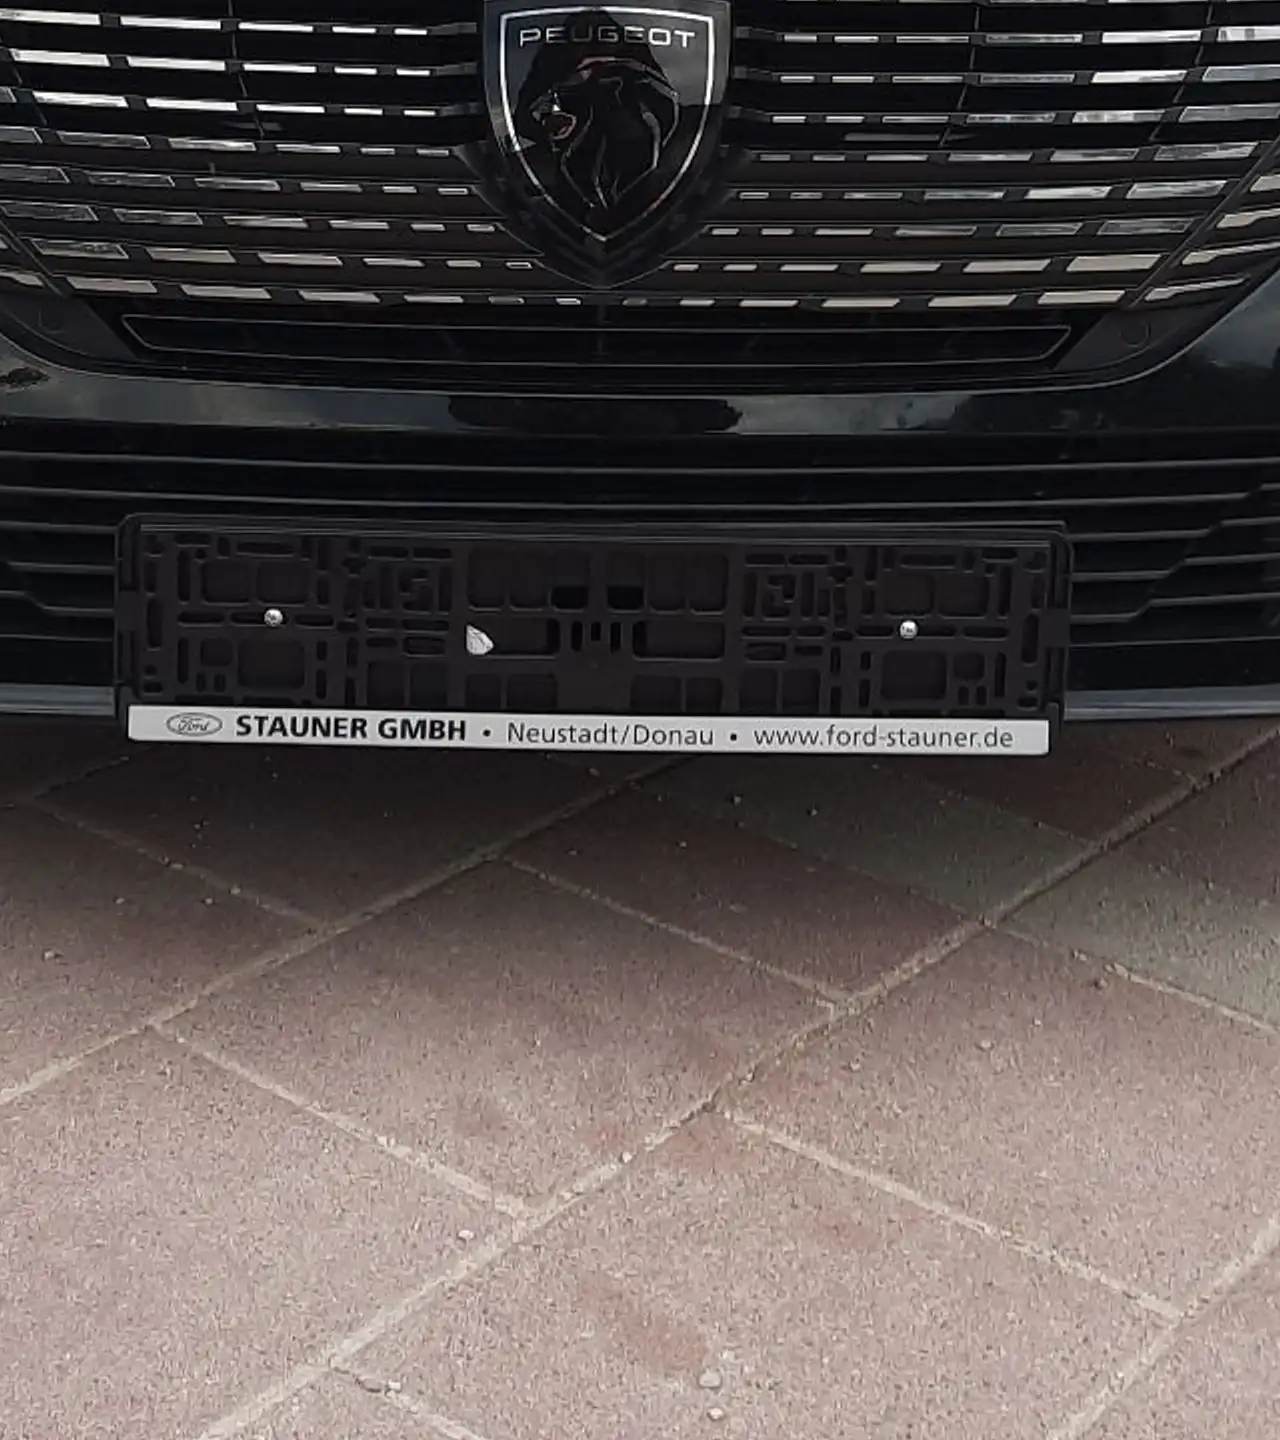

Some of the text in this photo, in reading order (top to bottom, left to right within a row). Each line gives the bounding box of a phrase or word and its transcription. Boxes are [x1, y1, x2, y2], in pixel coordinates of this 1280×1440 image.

[519, 26, 697, 49] PEUGEOT
[235, 714, 1014, 750] STAUNER GMBH Neustadt/Donau www.ford-stauner.de
